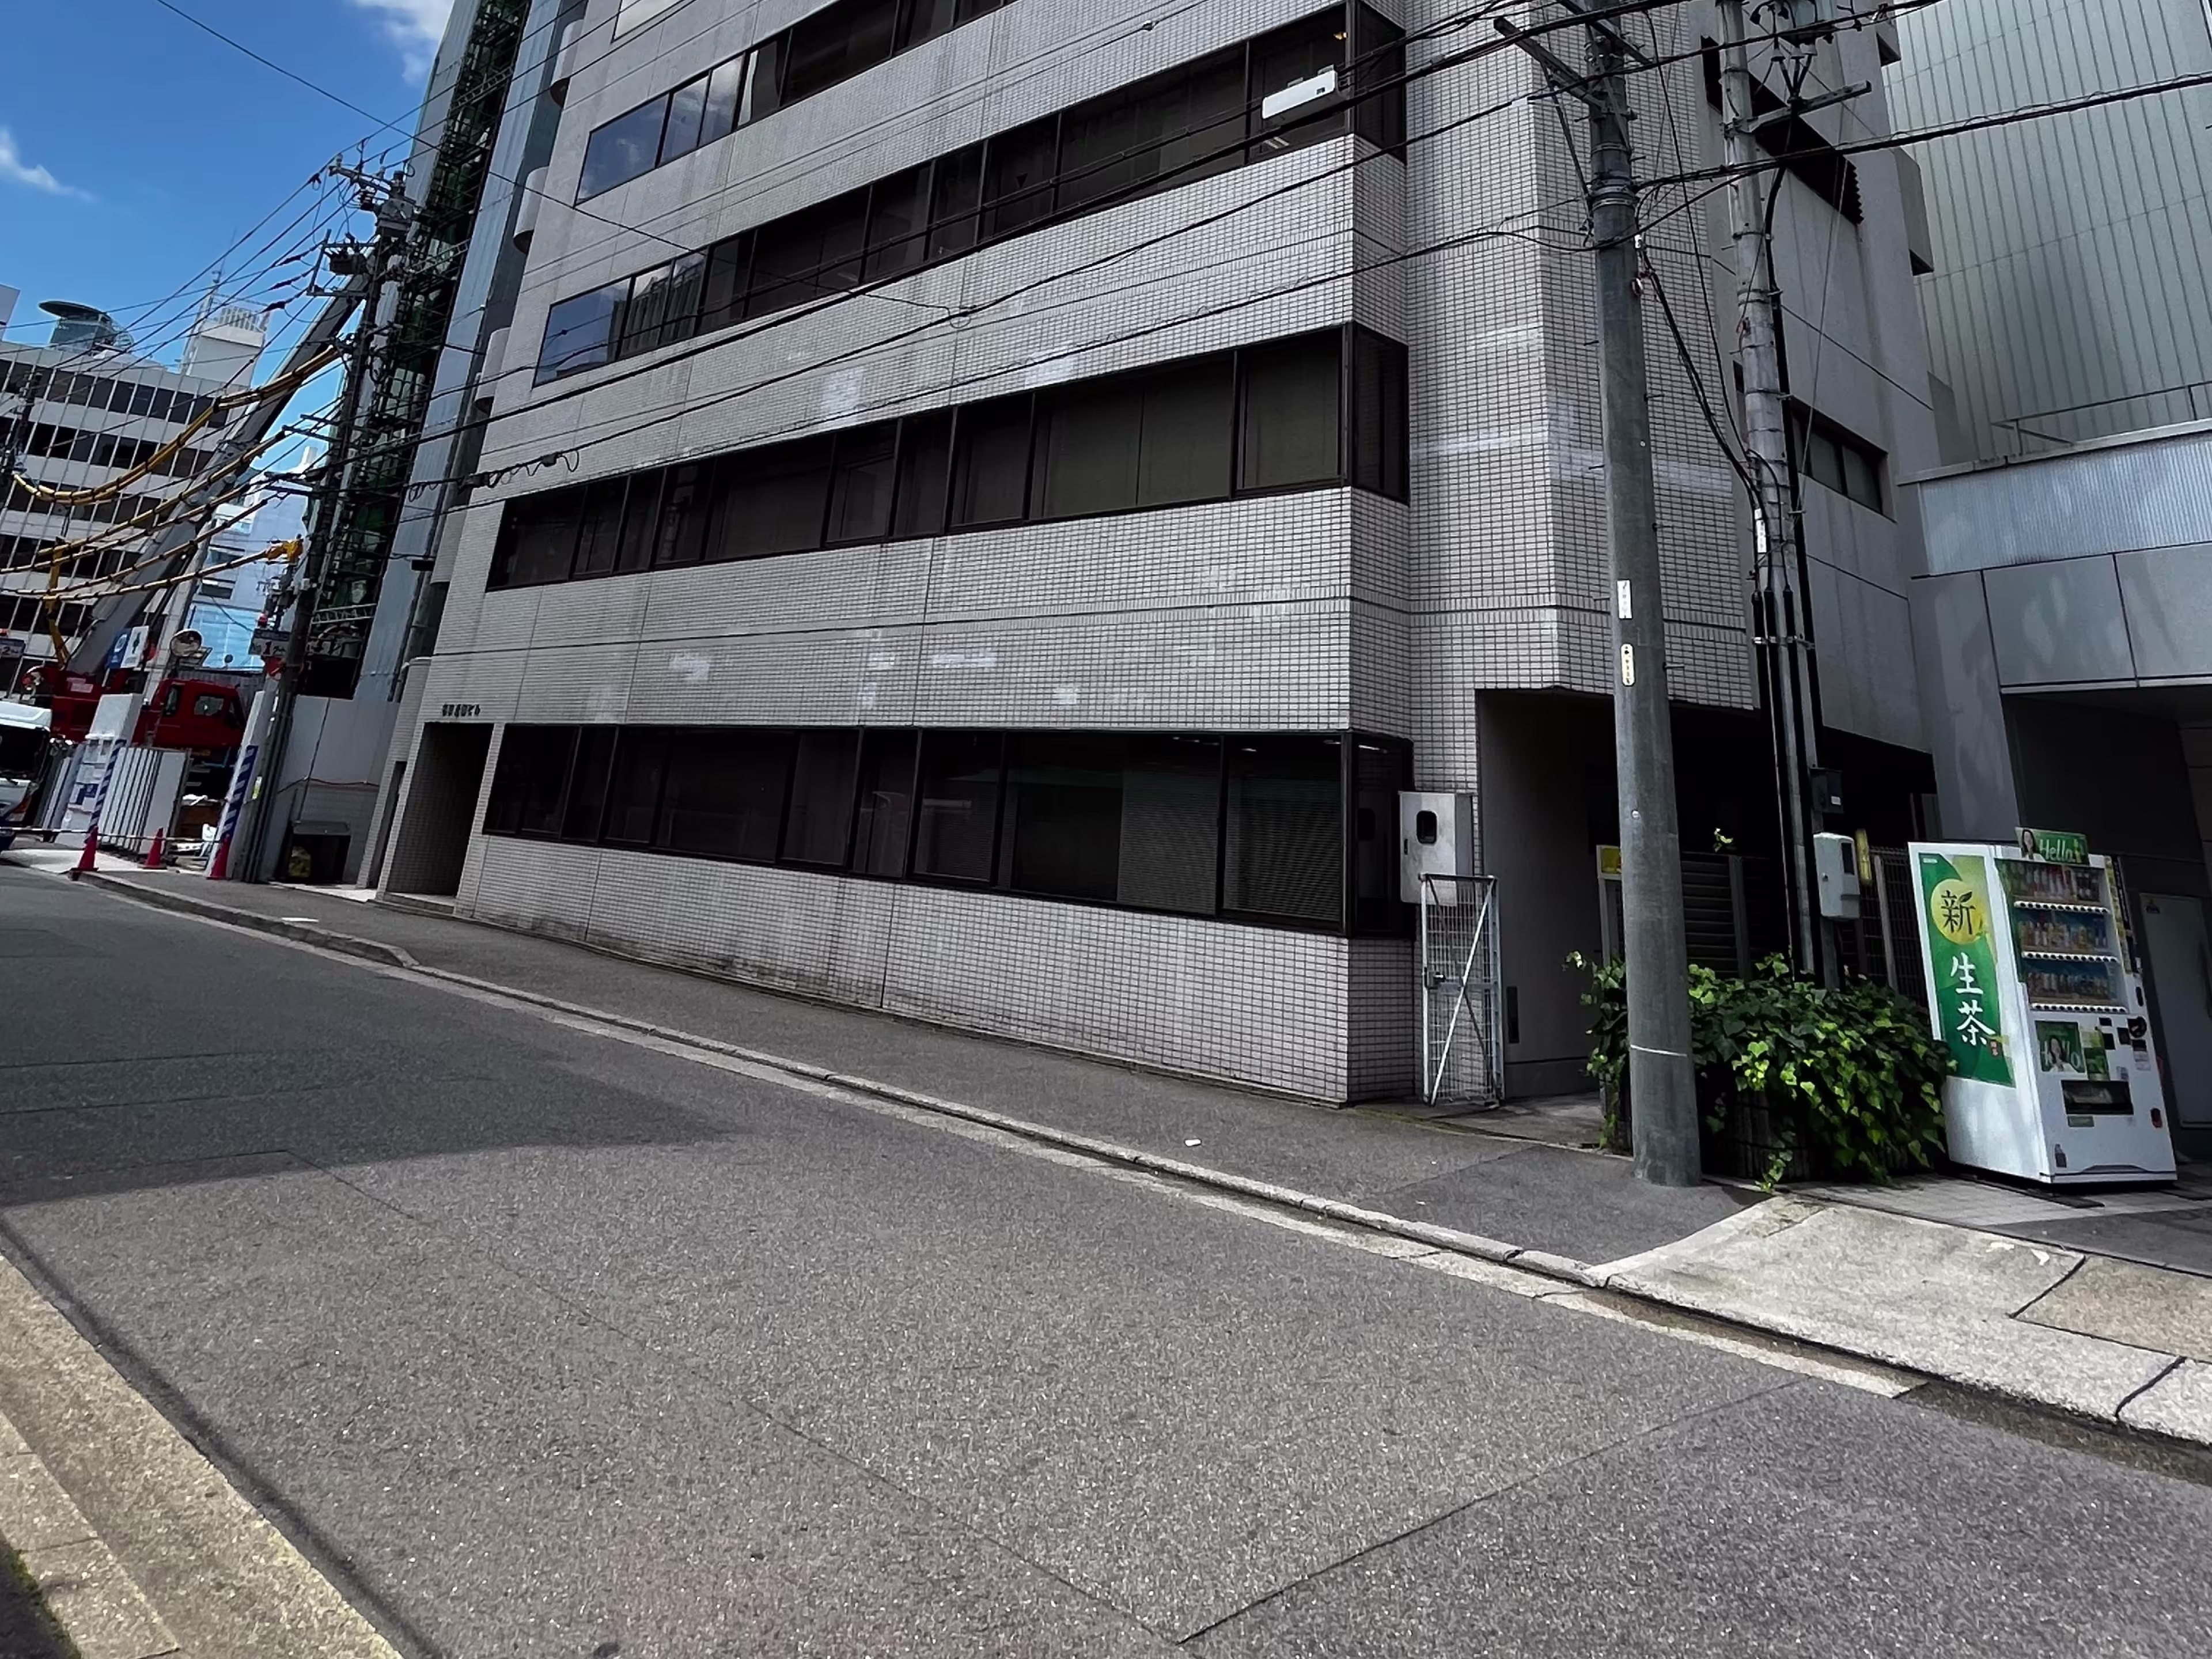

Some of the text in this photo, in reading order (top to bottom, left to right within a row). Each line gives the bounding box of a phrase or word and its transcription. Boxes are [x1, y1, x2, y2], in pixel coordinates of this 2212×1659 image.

[2040, 839, 2074, 862] Hello
[1941, 890, 1996, 1046] 新 生茶
